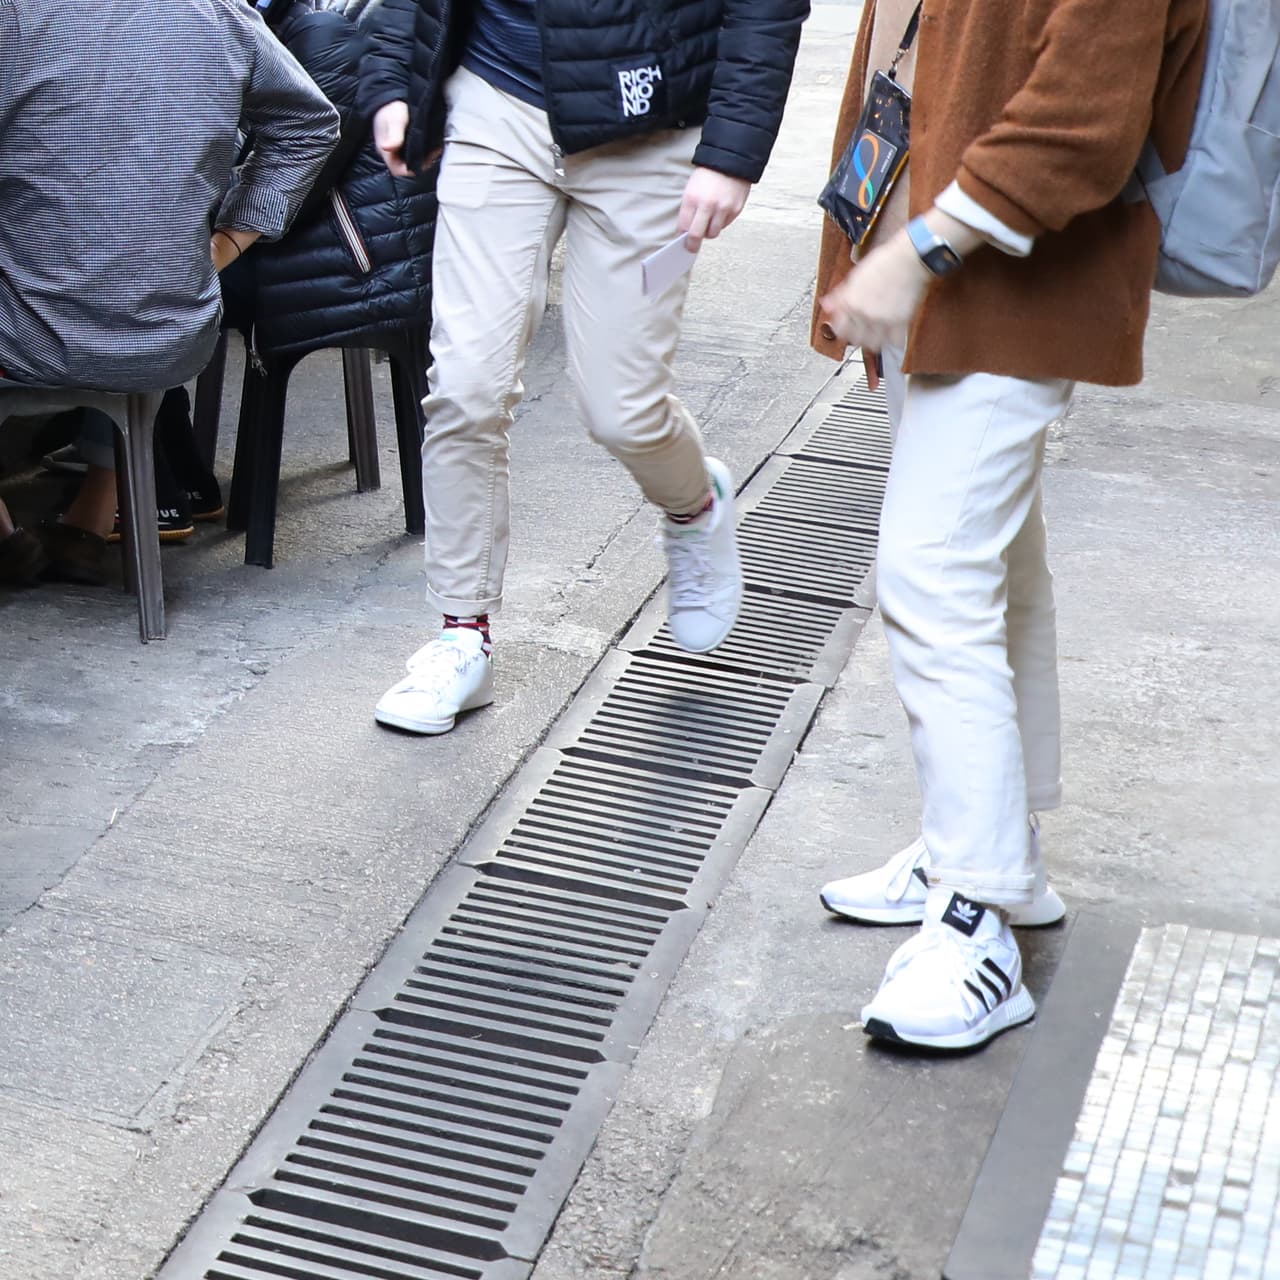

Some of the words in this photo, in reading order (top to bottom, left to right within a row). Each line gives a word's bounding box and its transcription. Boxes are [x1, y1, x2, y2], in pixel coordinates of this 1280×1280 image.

[618, 65, 662, 87] RICH
[621, 82, 653, 102] MO
[622, 98, 650, 117] ND
